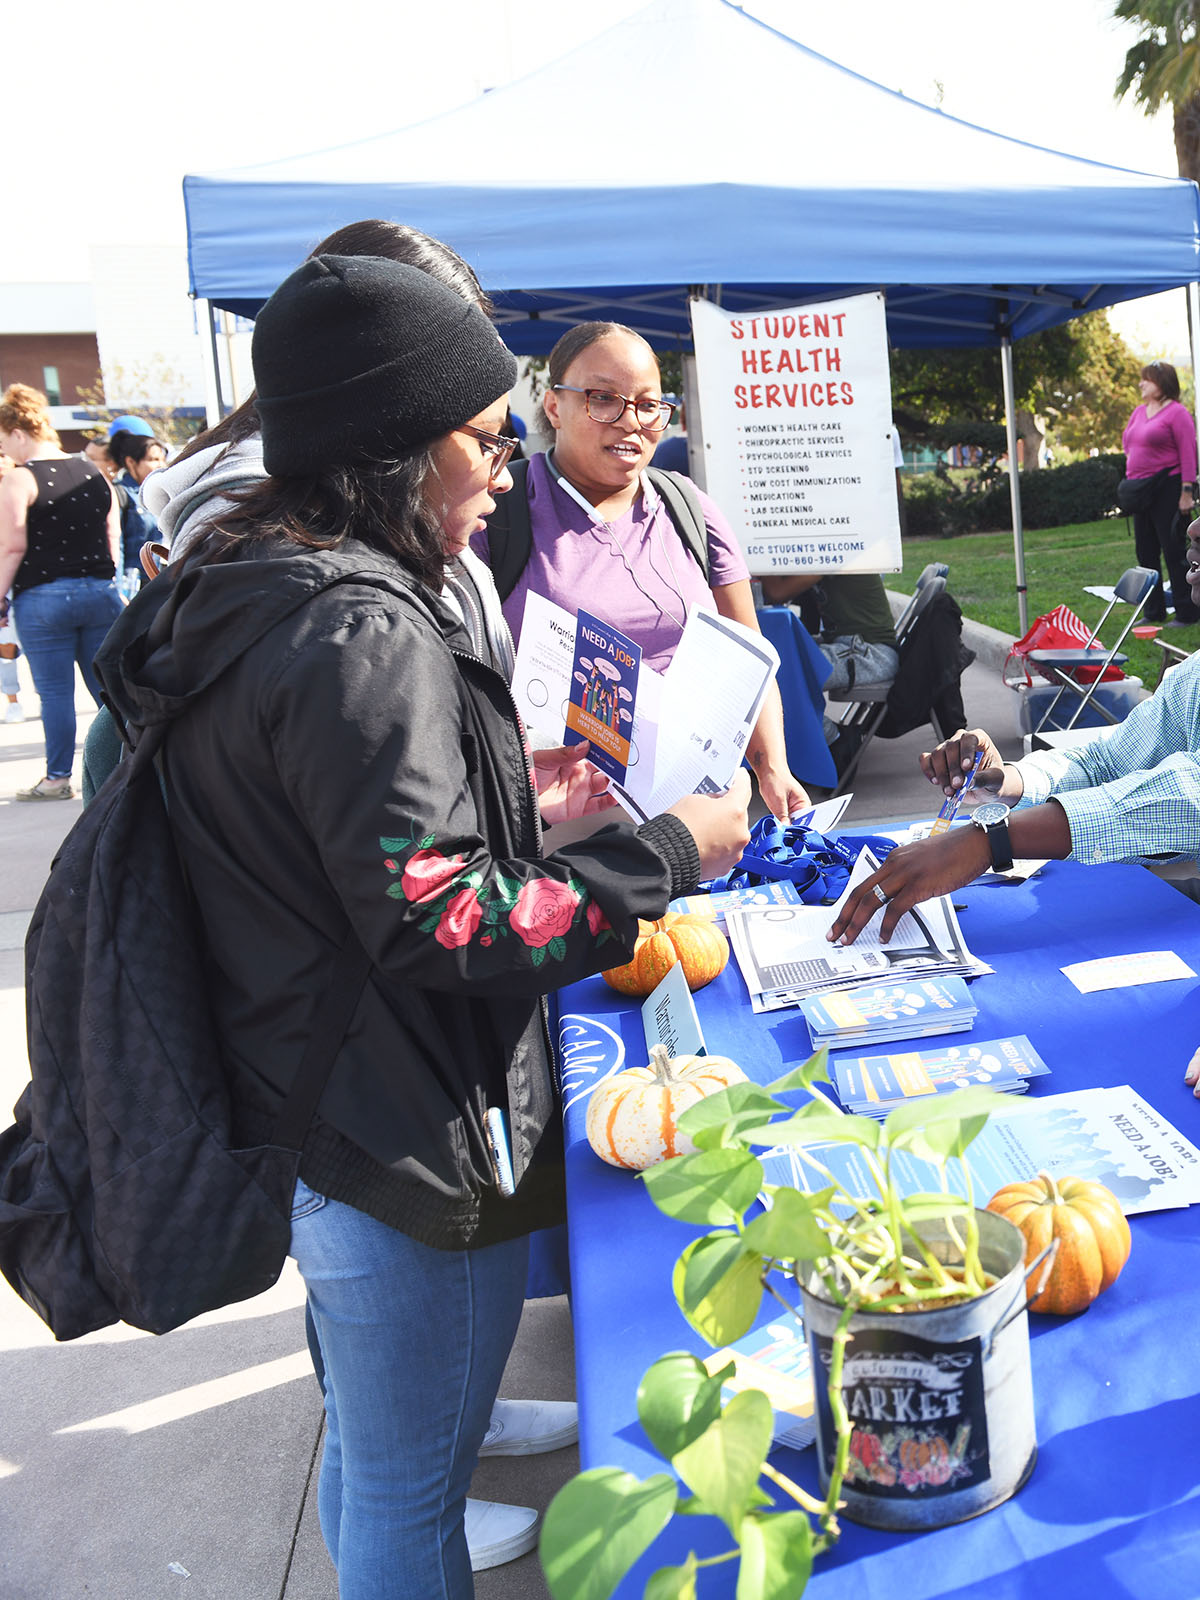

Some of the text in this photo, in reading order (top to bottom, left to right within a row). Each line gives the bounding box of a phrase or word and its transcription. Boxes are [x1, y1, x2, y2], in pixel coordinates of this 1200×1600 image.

[730, 313, 846, 340] STUDENT
[741, 347, 842, 374] HEALTH
[734, 382, 854, 409] SERVICES
[744, 423, 842, 433] WOMEN'S HEALTH CARE
[745, 436, 844, 447] CHIROPRACTIC SERVICES
[747, 450, 853, 460] PSYCHOLOGICAL SERVICES
[748, 465, 810, 474] STD SCREENING
[749, 477, 862, 488] LOW COST IMMUNIZATIONS
[750, 492, 805, 501] MEDICATIONS
[751, 505, 813, 515] LAB SCREENING
[752, 517, 850, 528] GENERAL MEDICAL CARE
[747, 541, 865, 555] ECC STUDENTS WELCOME
[582, 626, 607, 650] NEED
[607, 643, 615, 656] A
[614, 648, 636, 670] JOB?
[655, 993, 673, 1042] Warrior
[1109, 1114, 1178, 1180] NEED A JOB?
